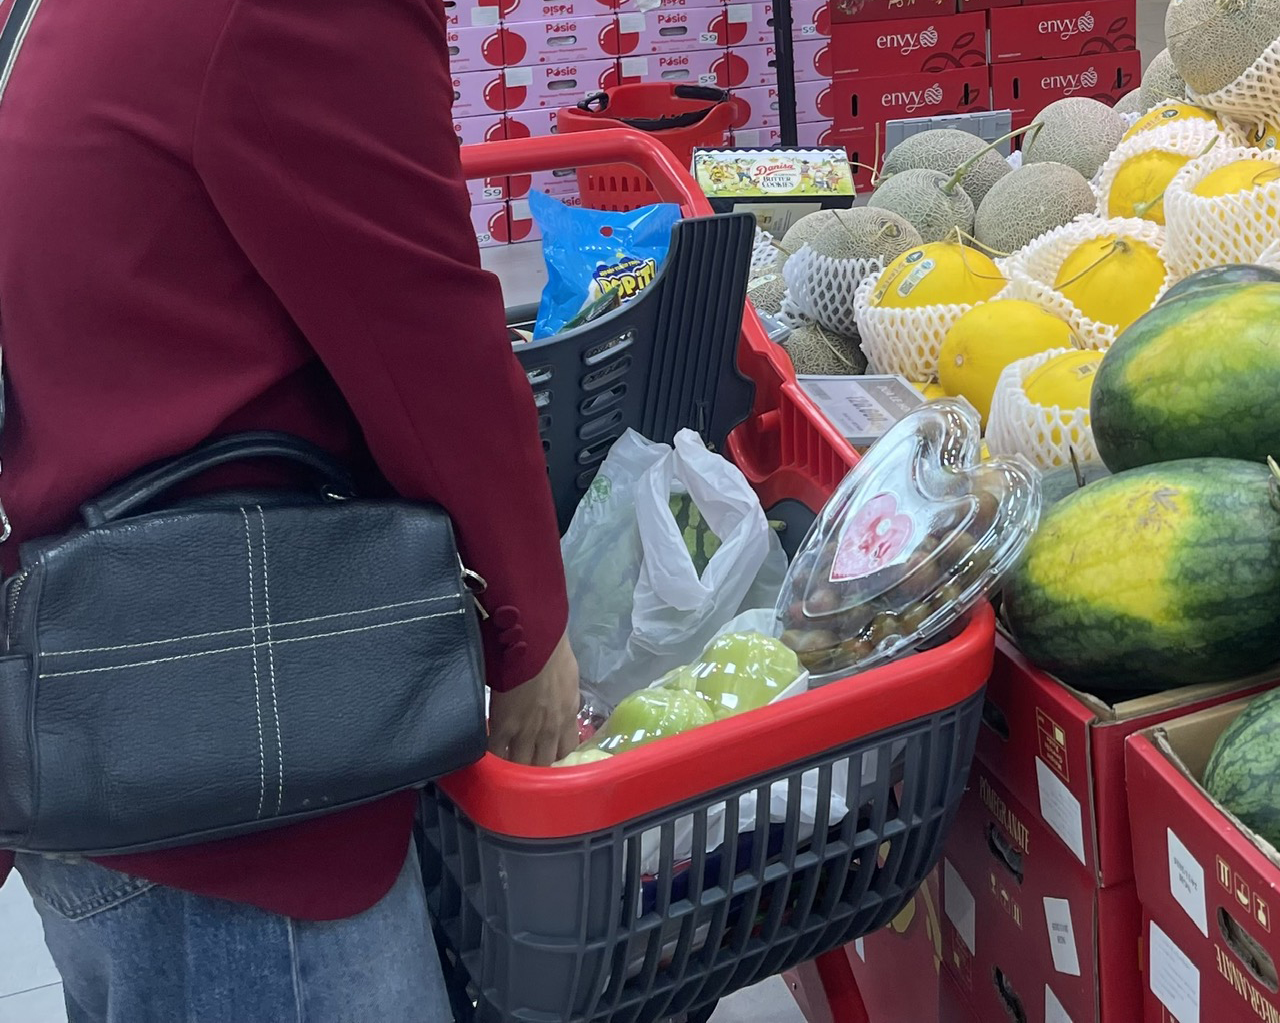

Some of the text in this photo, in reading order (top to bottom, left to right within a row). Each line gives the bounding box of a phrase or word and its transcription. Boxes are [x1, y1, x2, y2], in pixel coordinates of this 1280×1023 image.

[1038, 19, 1079, 40] envy
[876, 33, 920, 55] envy
[1041, 75, 1082, 95] envy
[881, 90, 925, 112] envy
[754, 163, 796, 177] Danisa
[979, 775, 1030, 856] POMEGRANATE
